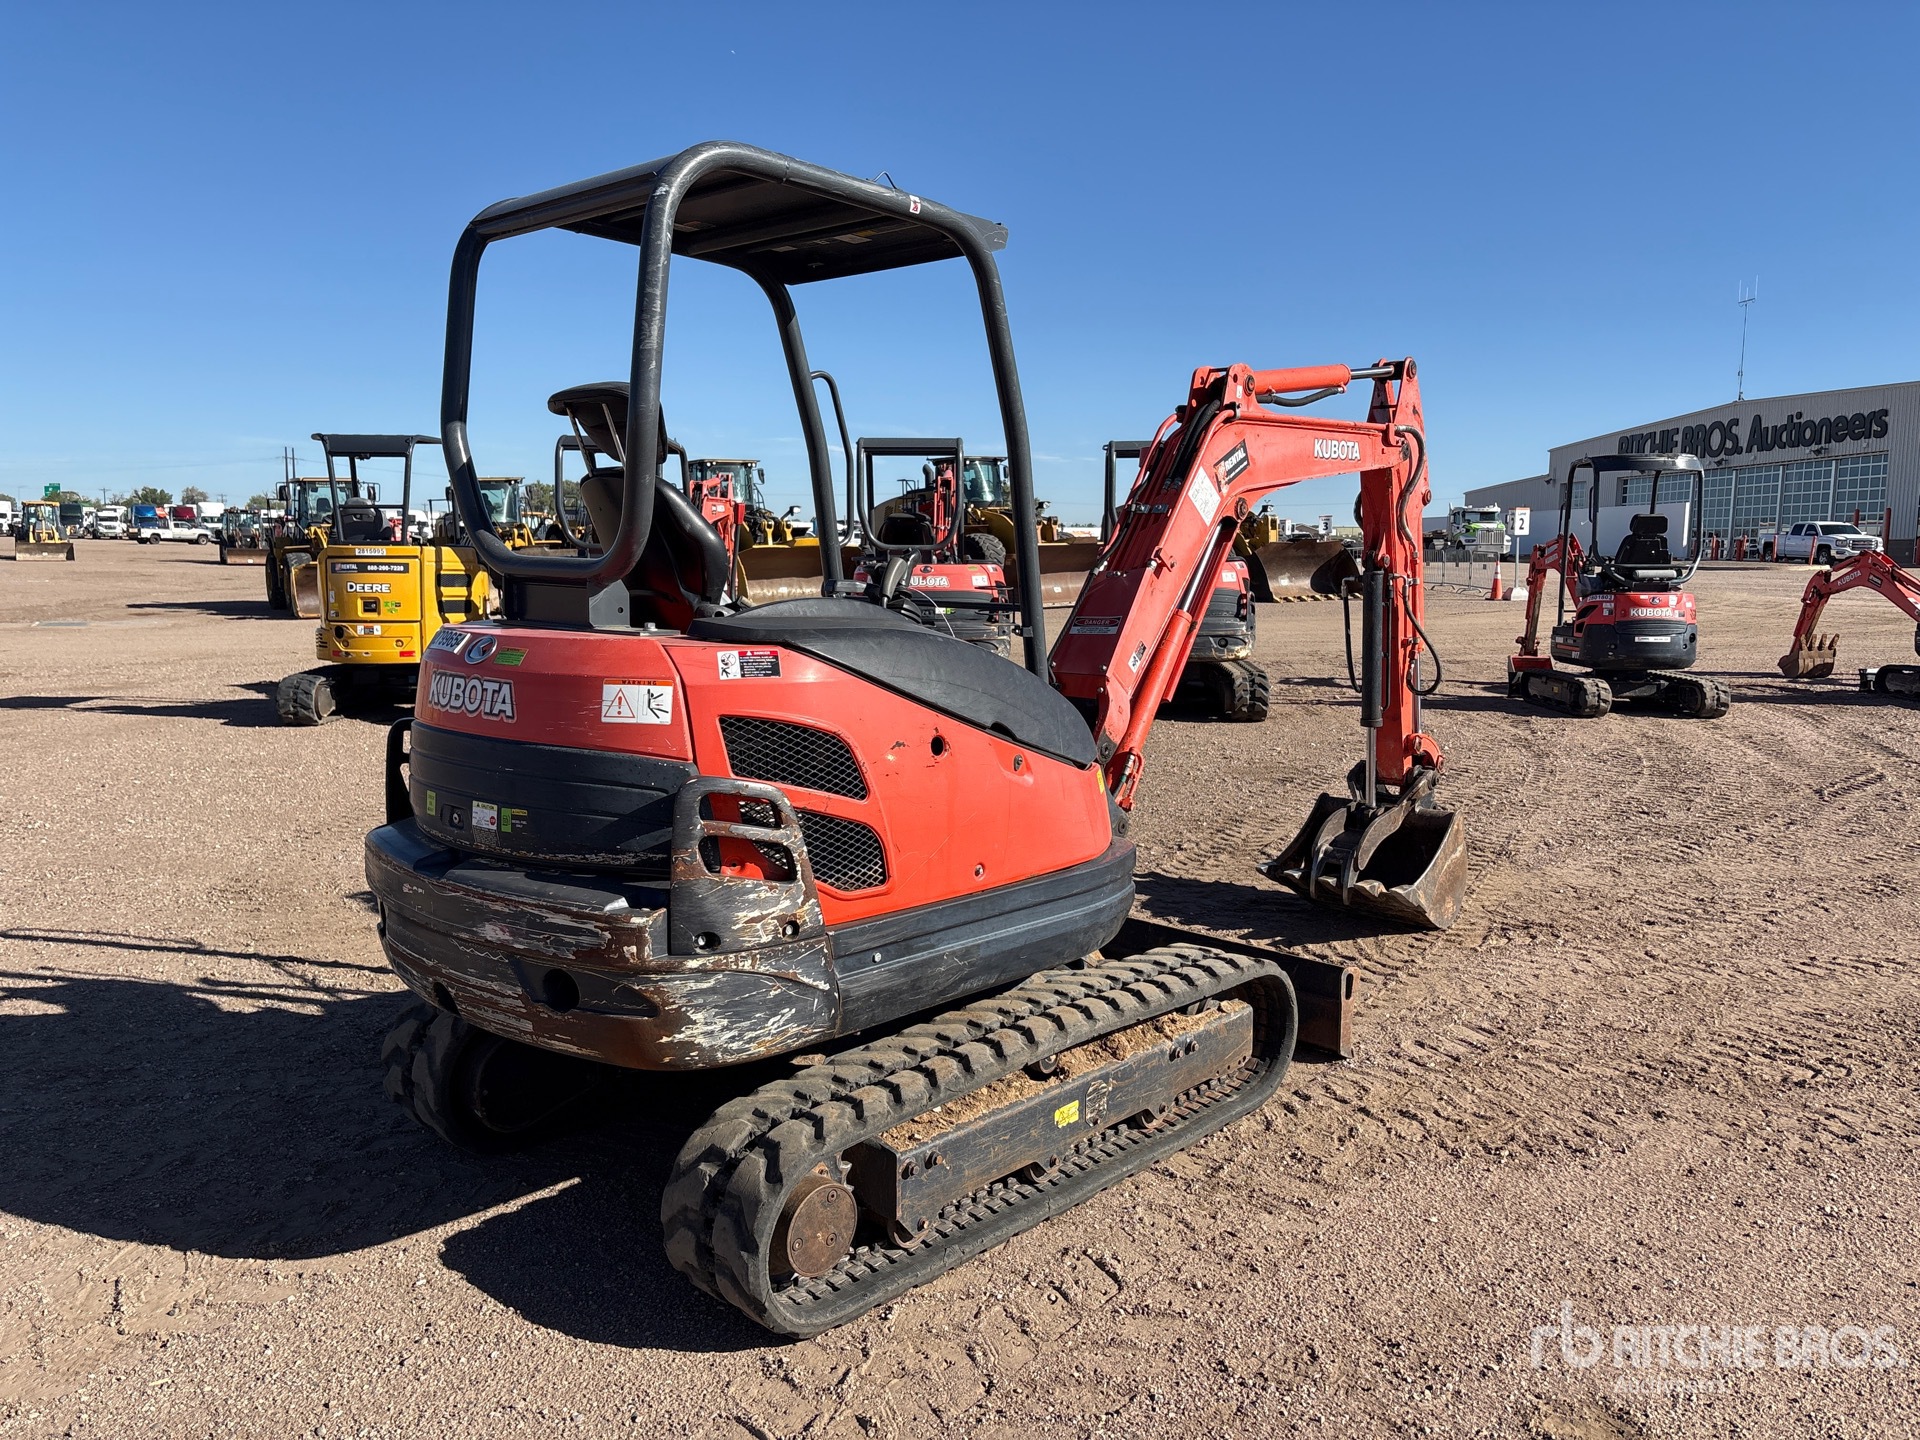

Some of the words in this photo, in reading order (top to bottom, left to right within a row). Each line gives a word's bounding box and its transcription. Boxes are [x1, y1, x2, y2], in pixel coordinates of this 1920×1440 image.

[1681, 417, 1743, 459] BROS.
[1745, 408, 1889, 454] Auctioneers
[1313, 438, 1361, 461] KUBOTA
[1224, 447, 1246, 472] RENTAL
[1322, 521, 1329, 531] 3
[1518, 517, 1525, 530] 2
[908, 575, 950, 587] UBOTA
[1837, 570, 1862, 586] KUBOTA
[347, 581, 391, 593] DEERE
[1630, 608, 1673, 617] KUBOTA
[429, 671, 515, 718] KUBOTA
